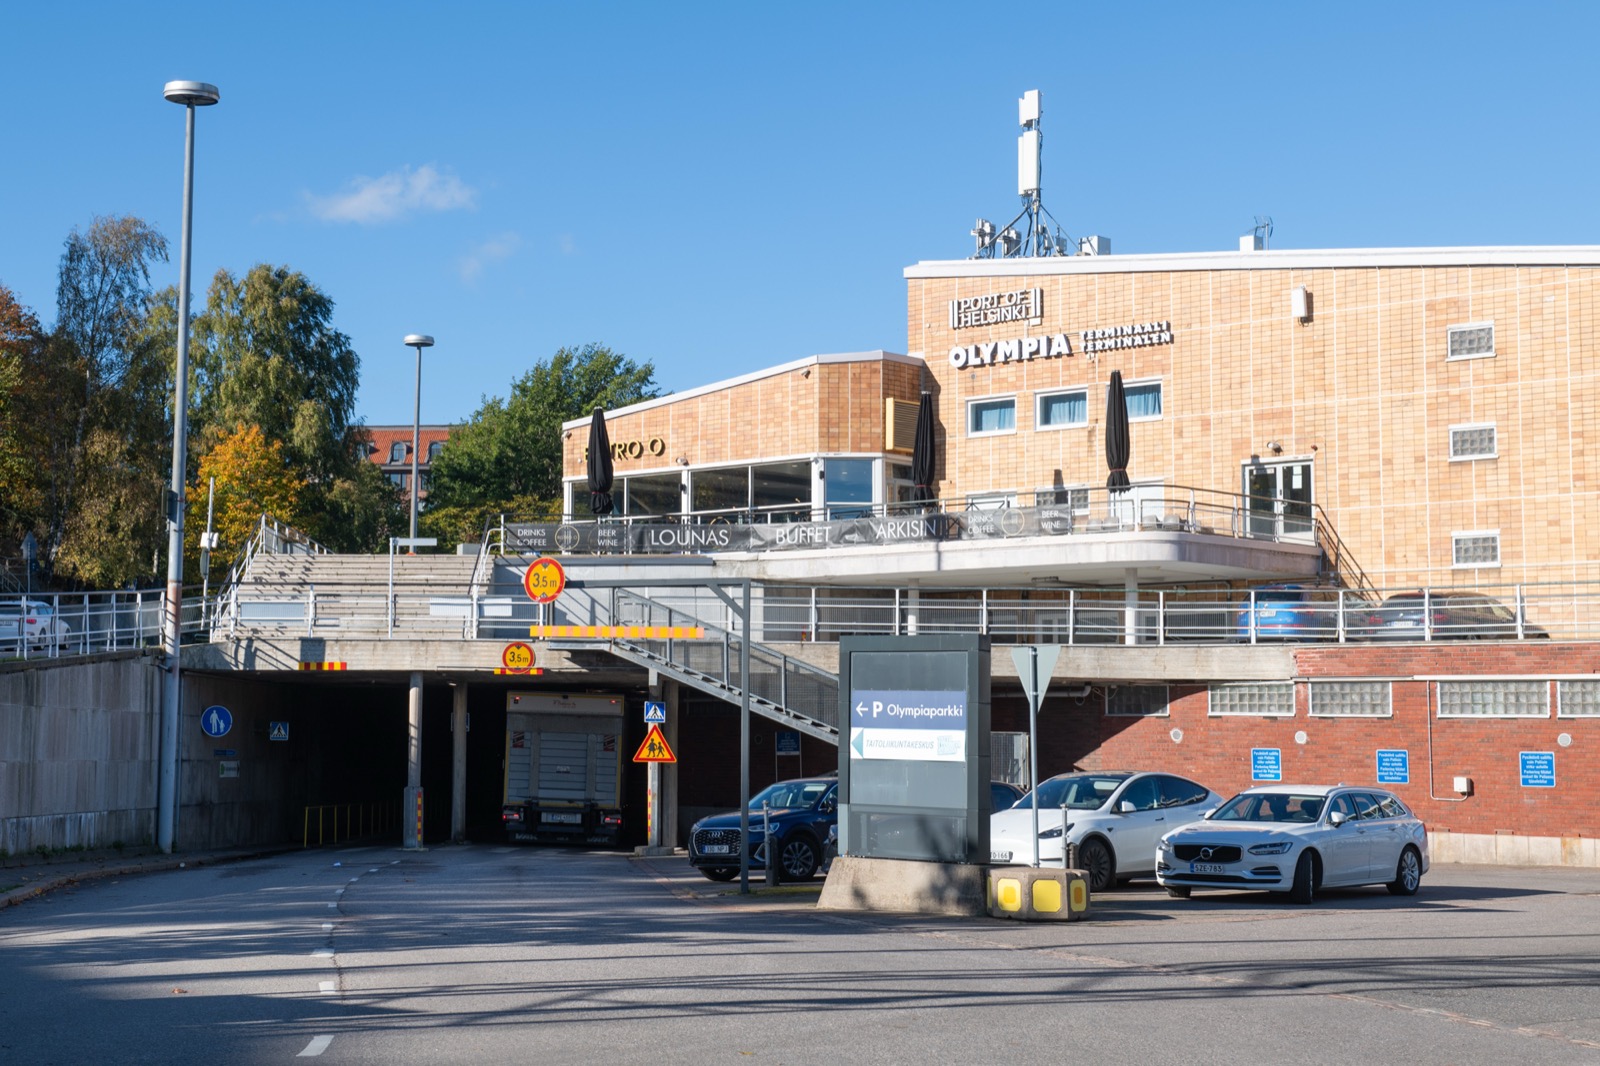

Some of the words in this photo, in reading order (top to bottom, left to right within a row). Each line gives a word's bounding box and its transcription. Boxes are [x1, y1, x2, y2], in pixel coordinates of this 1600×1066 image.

[959, 294, 1000, 312] PORT
[1003, 289, 1026, 307] OF
[959, 304, 1027, 327] HELSINKI
[1079, 320, 1168, 341] TERMINAALI
[1079, 332, 1172, 353] TERMINALEN
[948, 334, 1072, 369] OLYMPIA
[1041, 510, 1059, 518] BEER
[967, 514, 994, 524] DRINKS
[1041, 520, 1061, 529] WINE
[517, 529, 546, 537] DRINKS
[598, 529, 617, 537] BEER
[651, 529, 729, 546] LOUNAS
[776, 526, 832, 544] BUFFET
[875, 519, 936, 540] ARKISIN
[967, 525, 995, 534] COFFEE
[517, 538, 547, 547] COFFEE
[597, 538, 618, 547] WINE
[549, 579, 557, 588] m
[509, 651, 522, 664] 3,5
[872, 701, 883, 718] P
[887, 703, 963, 719] Olympiaparkki
[1194, 864, 1223, 873] SZE-783
